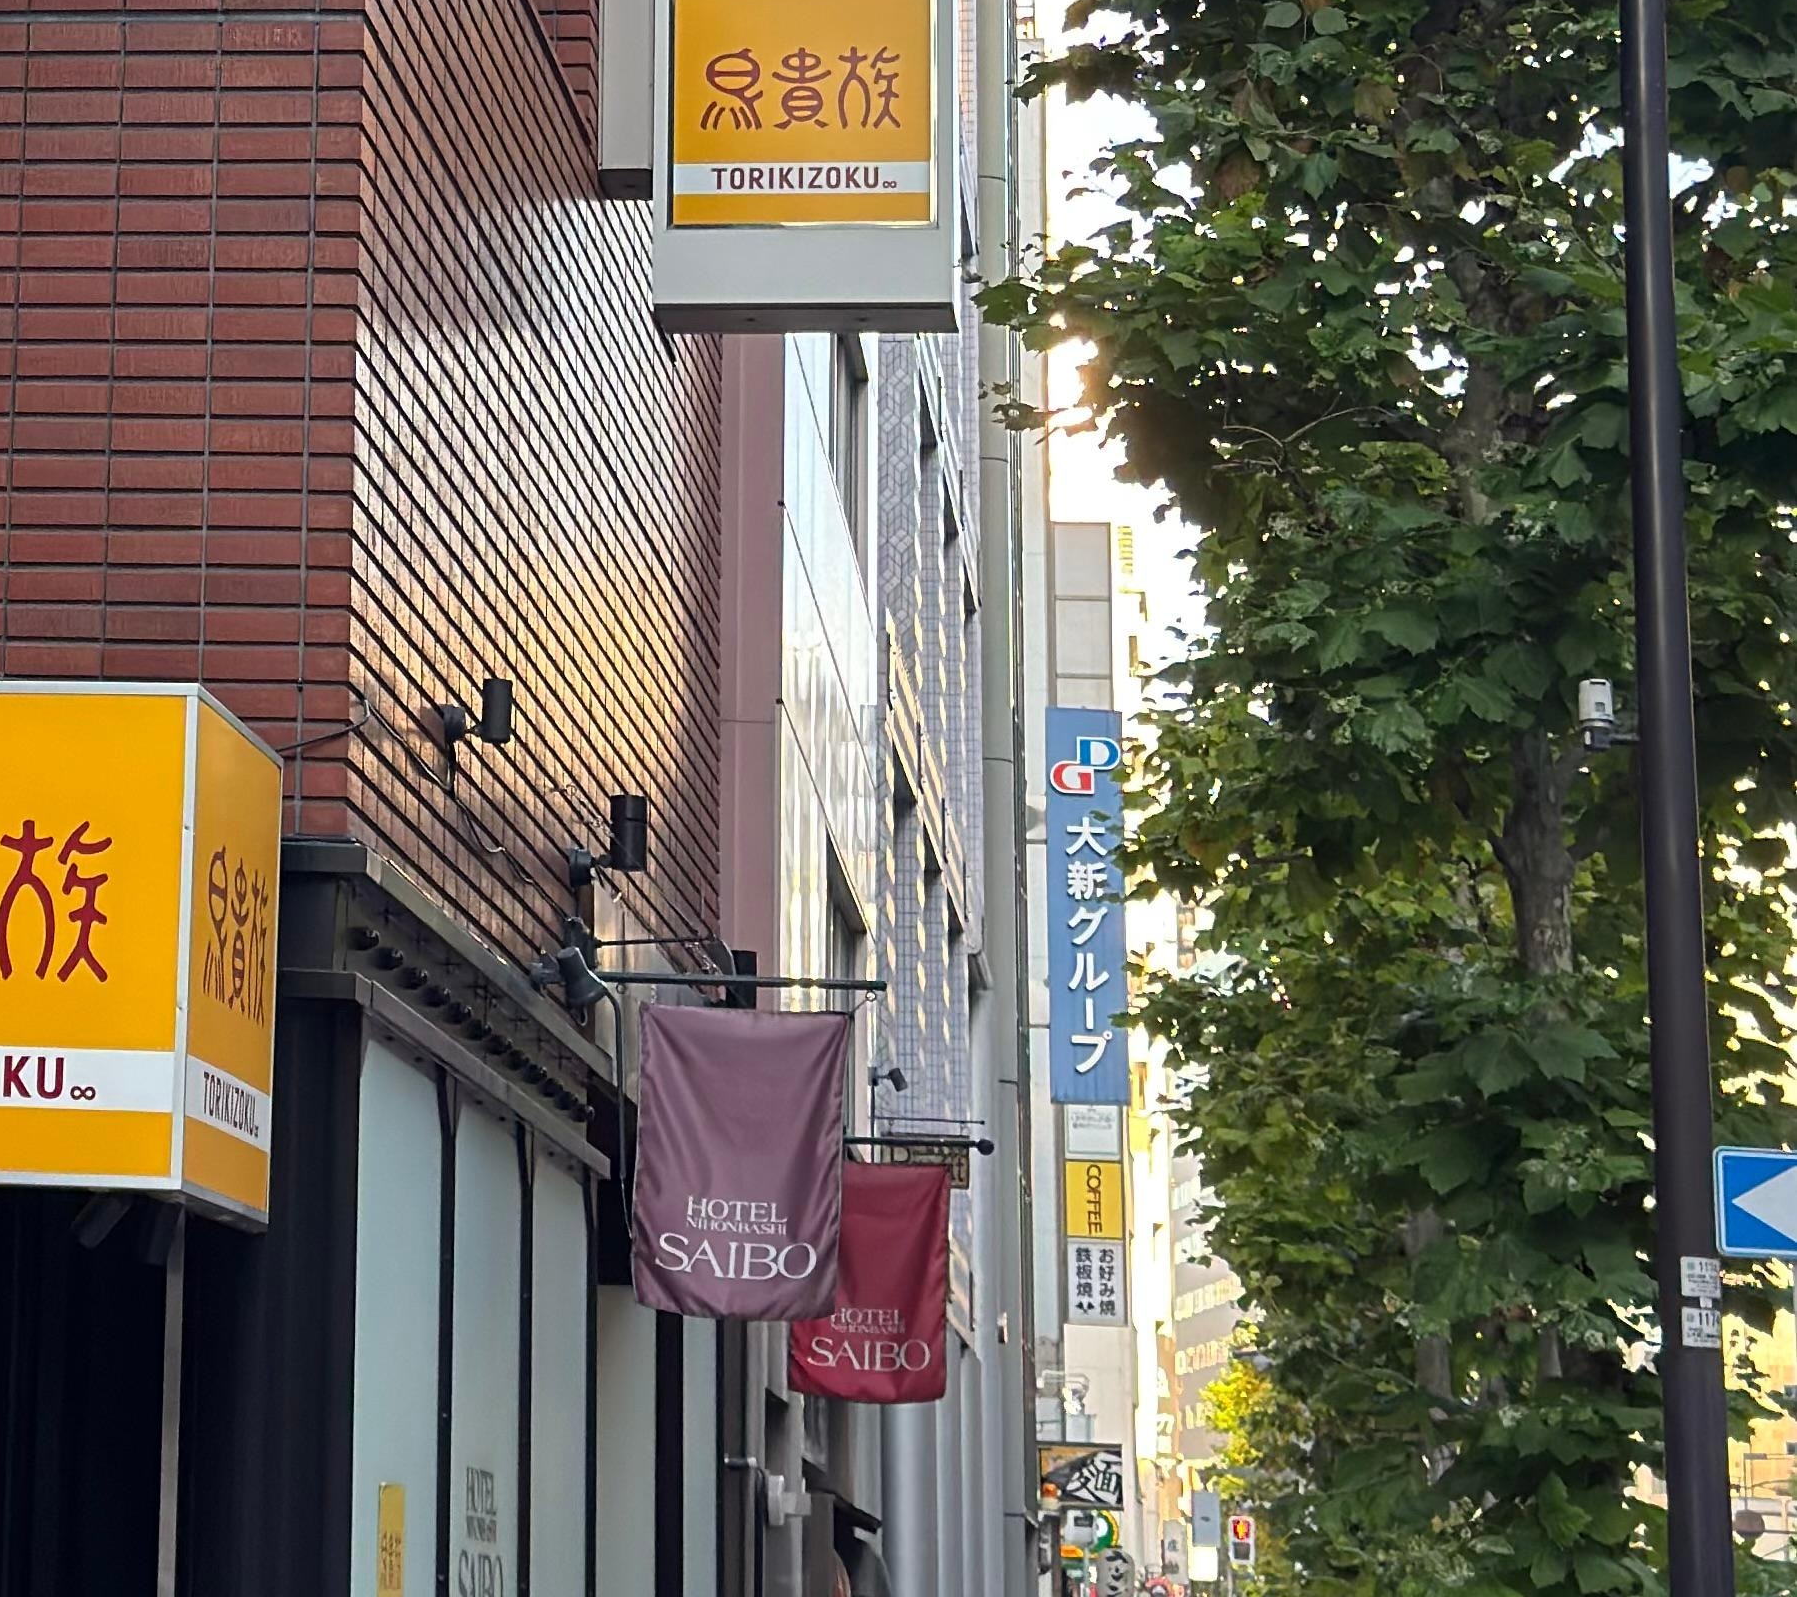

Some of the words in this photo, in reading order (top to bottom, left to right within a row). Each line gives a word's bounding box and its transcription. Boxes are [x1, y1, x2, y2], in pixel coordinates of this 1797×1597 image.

[1065, 817, 1113, 1073] 大新グループ
[686, 1195, 789, 1224] HOTEL
[1086, 1164, 1103, 1235] COFFEE
[686, 1216, 788, 1237] NIHONBASHI
[654, 1232, 818, 1282] SAIBO
[1076, 1247, 1093, 1299] 鉄板焼
[1099, 1248, 1116, 1317] お好み焼
[806, 1336, 932, 1373] SAIBO
[466, 1466, 497, 1517] HOTEL
